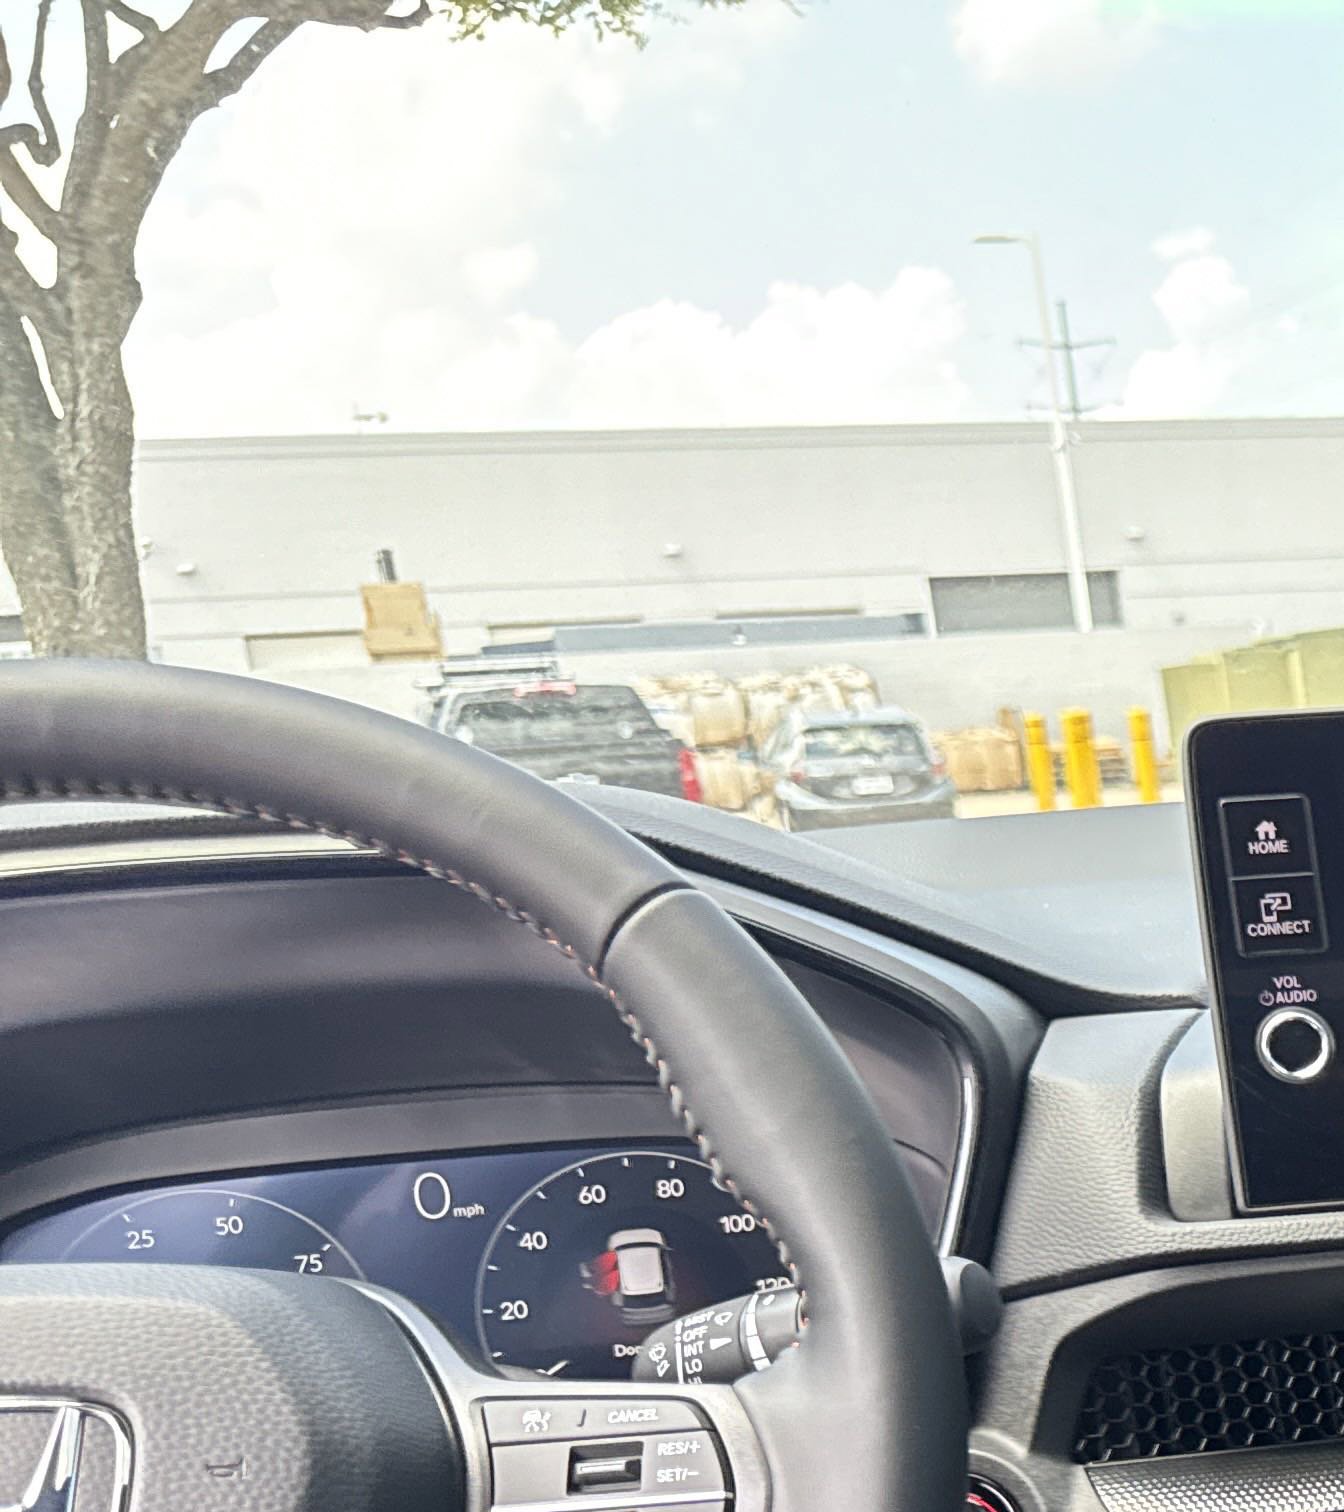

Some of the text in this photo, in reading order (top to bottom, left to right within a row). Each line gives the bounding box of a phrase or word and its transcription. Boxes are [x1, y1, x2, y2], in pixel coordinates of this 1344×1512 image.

[1247, 839, 1290, 855] HOME
[1247, 920, 1312, 936] CONNECT
[1273, 975, 1302, 990] VOL
[1276, 989, 1318, 1004] AUDIO
[413, 1172, 451, 1220] 0
[578, 1184, 607, 1206] 60
[656, 1178, 685, 1200] 80
[453, 1202, 485, 1218] mph
[215, 1215, 244, 1236] 50
[720, 1213, 756, 1234] 100
[127, 1230, 156, 1250] 25
[518, 1231, 548, 1252] 40
[294, 1253, 324, 1274] 75
[500, 1300, 529, 1322] 20
[683, 1325, 709, 1342] OFF
[684, 1341, 705, 1357] INT
[685, 1358, 703, 1375] LO
[607, 1408, 659, 1425] CANCEL
[656, 1440, 701, 1457] RES/+
